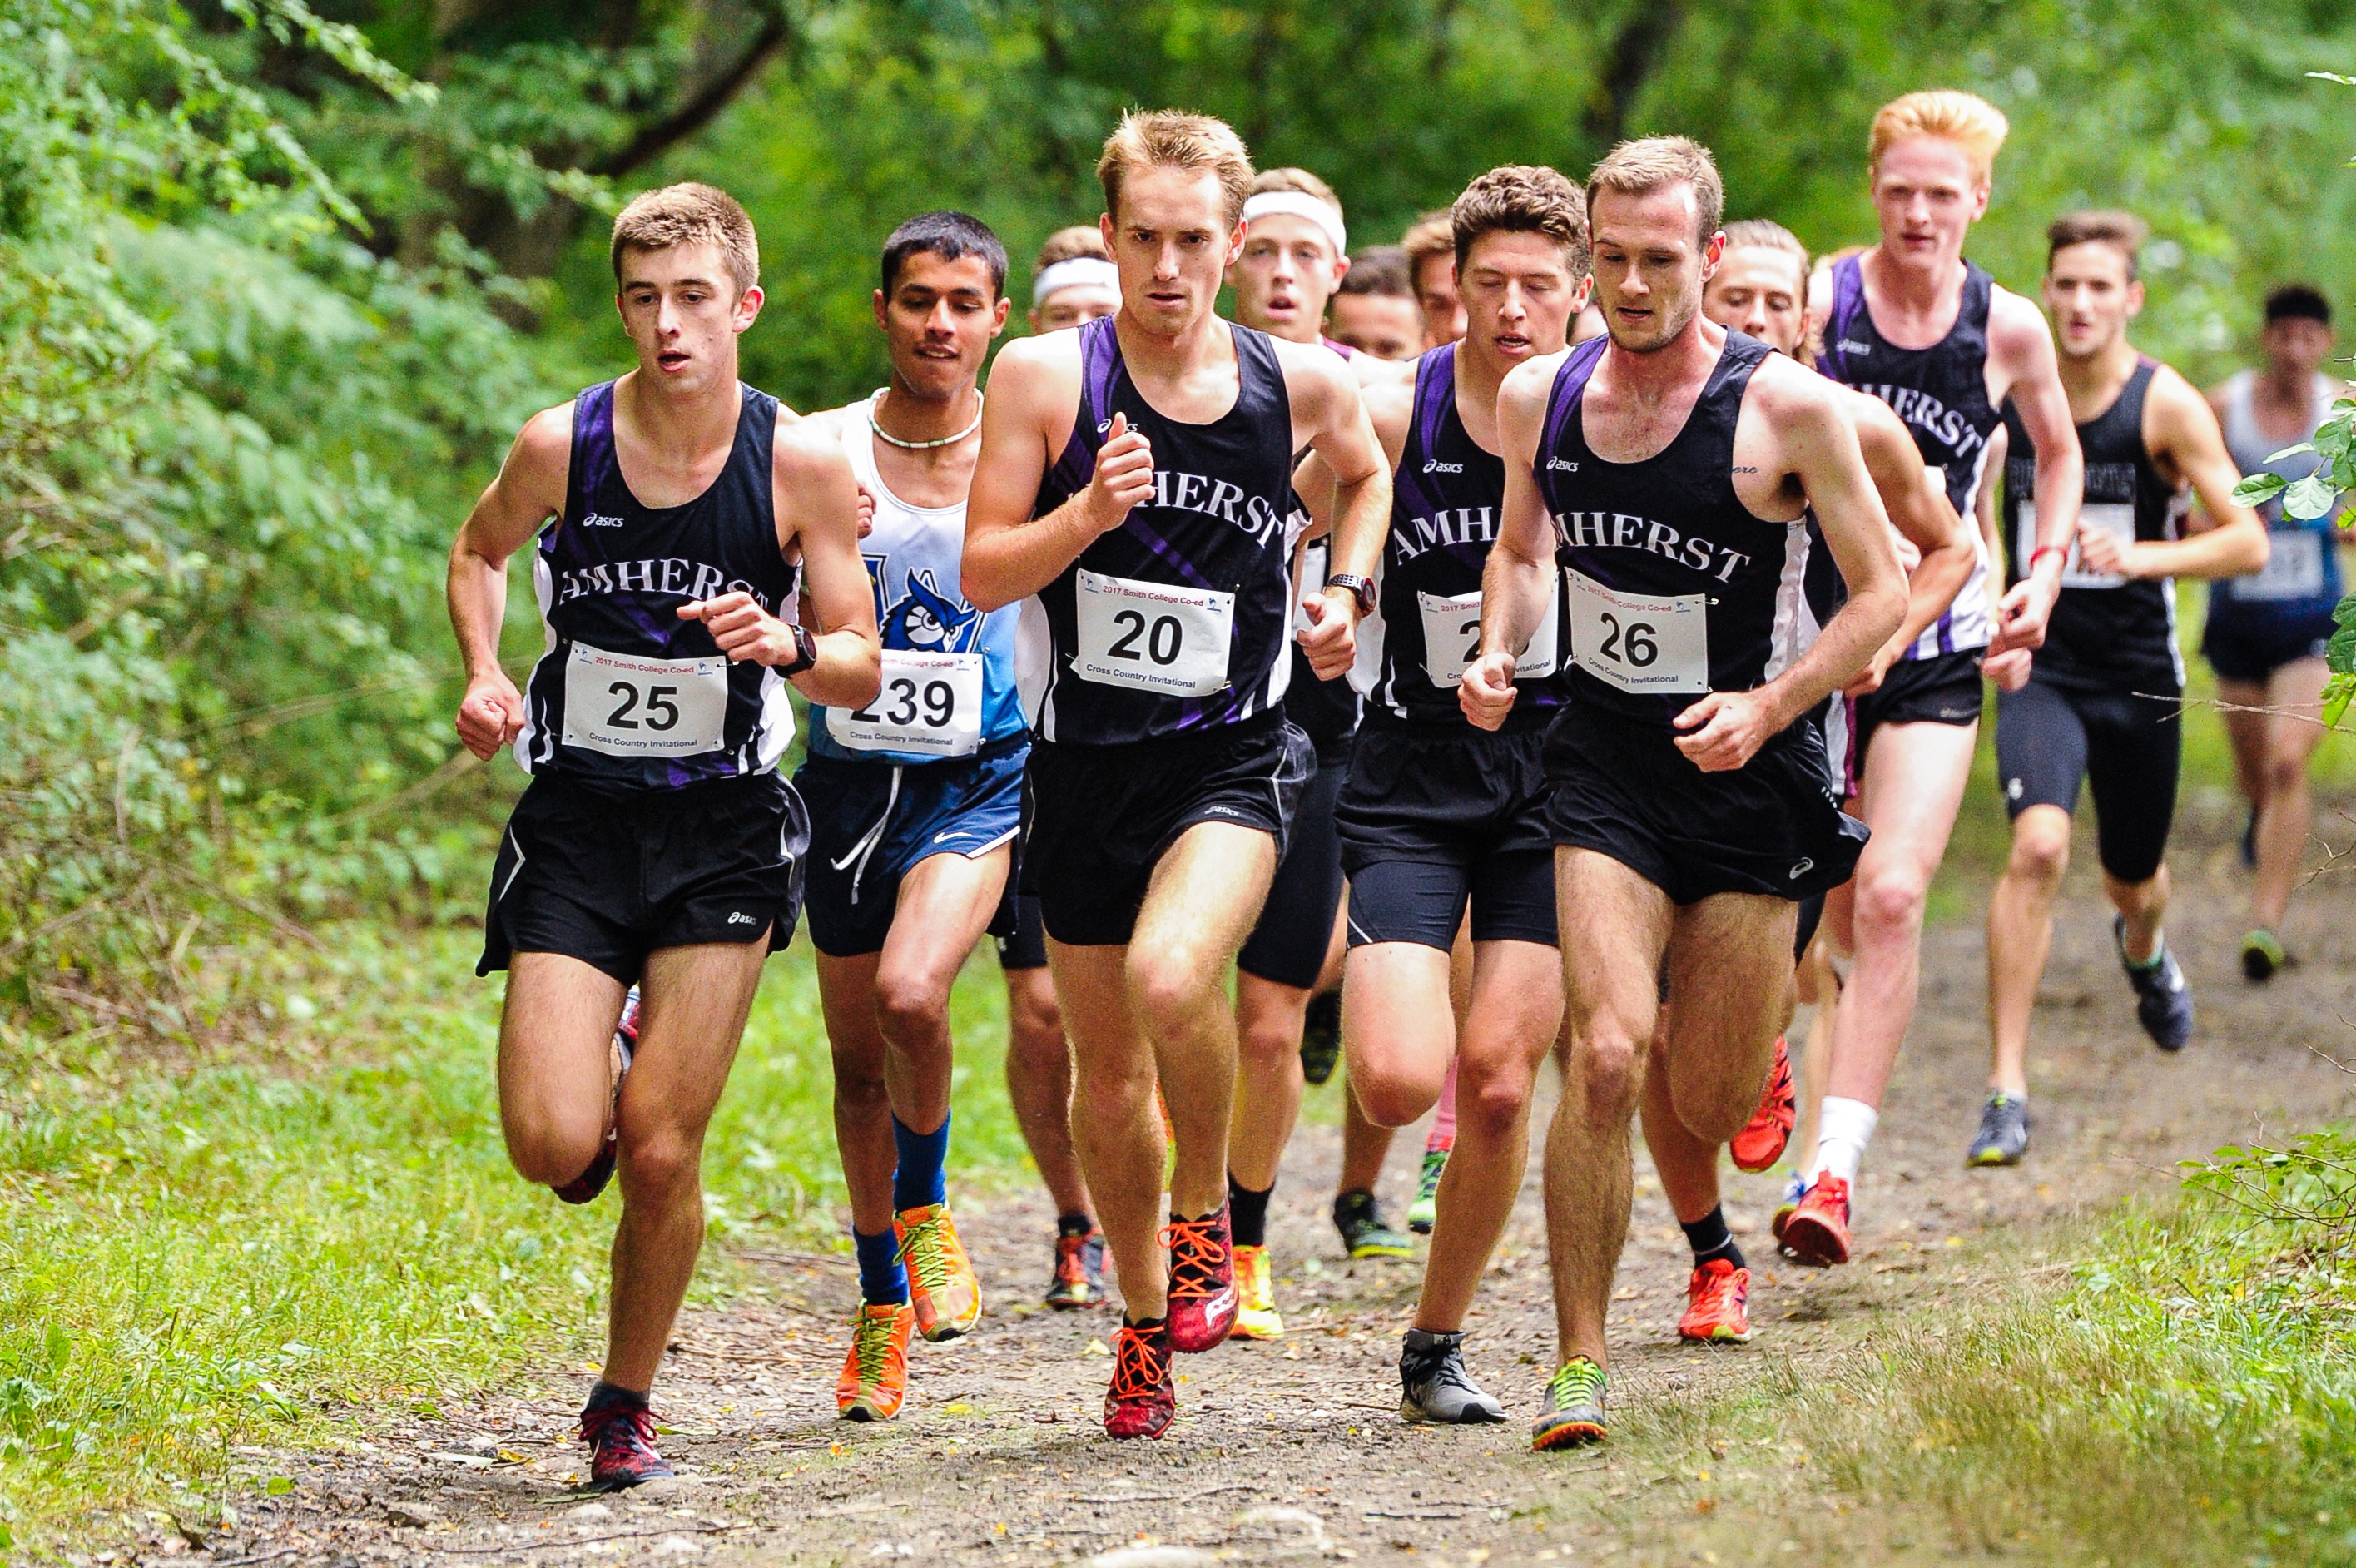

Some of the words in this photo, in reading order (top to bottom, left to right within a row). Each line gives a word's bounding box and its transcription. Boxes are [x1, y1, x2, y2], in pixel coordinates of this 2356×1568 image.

[1436, 462, 1464, 474] asics
[1555, 459, 1580, 473] asics
[595, 516, 624, 528] asics
[1103, 585, 1122, 595] 2017
[1123, 588, 1146, 599] Smith
[1148, 593, 1178, 604] College
[1180, 597, 1204, 607] Co-ed
[1107, 609, 1183, 666] 20
[1600, 612, 1658, 667] 26
[595, 656, 613, 667] 2017
[614, 660, 637, 670] Smith
[638, 664, 667, 675] College
[670, 666, 694, 674] Co-ed
[1086, 663, 1111, 676] Cross
[1113, 668, 1148, 682] Country
[1148, 674, 1196, 689] Invitational
[1631, 675, 1679, 684] Invitational
[606, 681, 679, 732] 25
[589, 732, 612, 744] Cross
[613, 738, 648, 749] Country
[650, 739, 697, 747] Invitational
[850, 731, 872, 740] Cross
[875, 732, 906, 743] Country
[908, 736, 953, 746] Invitational
